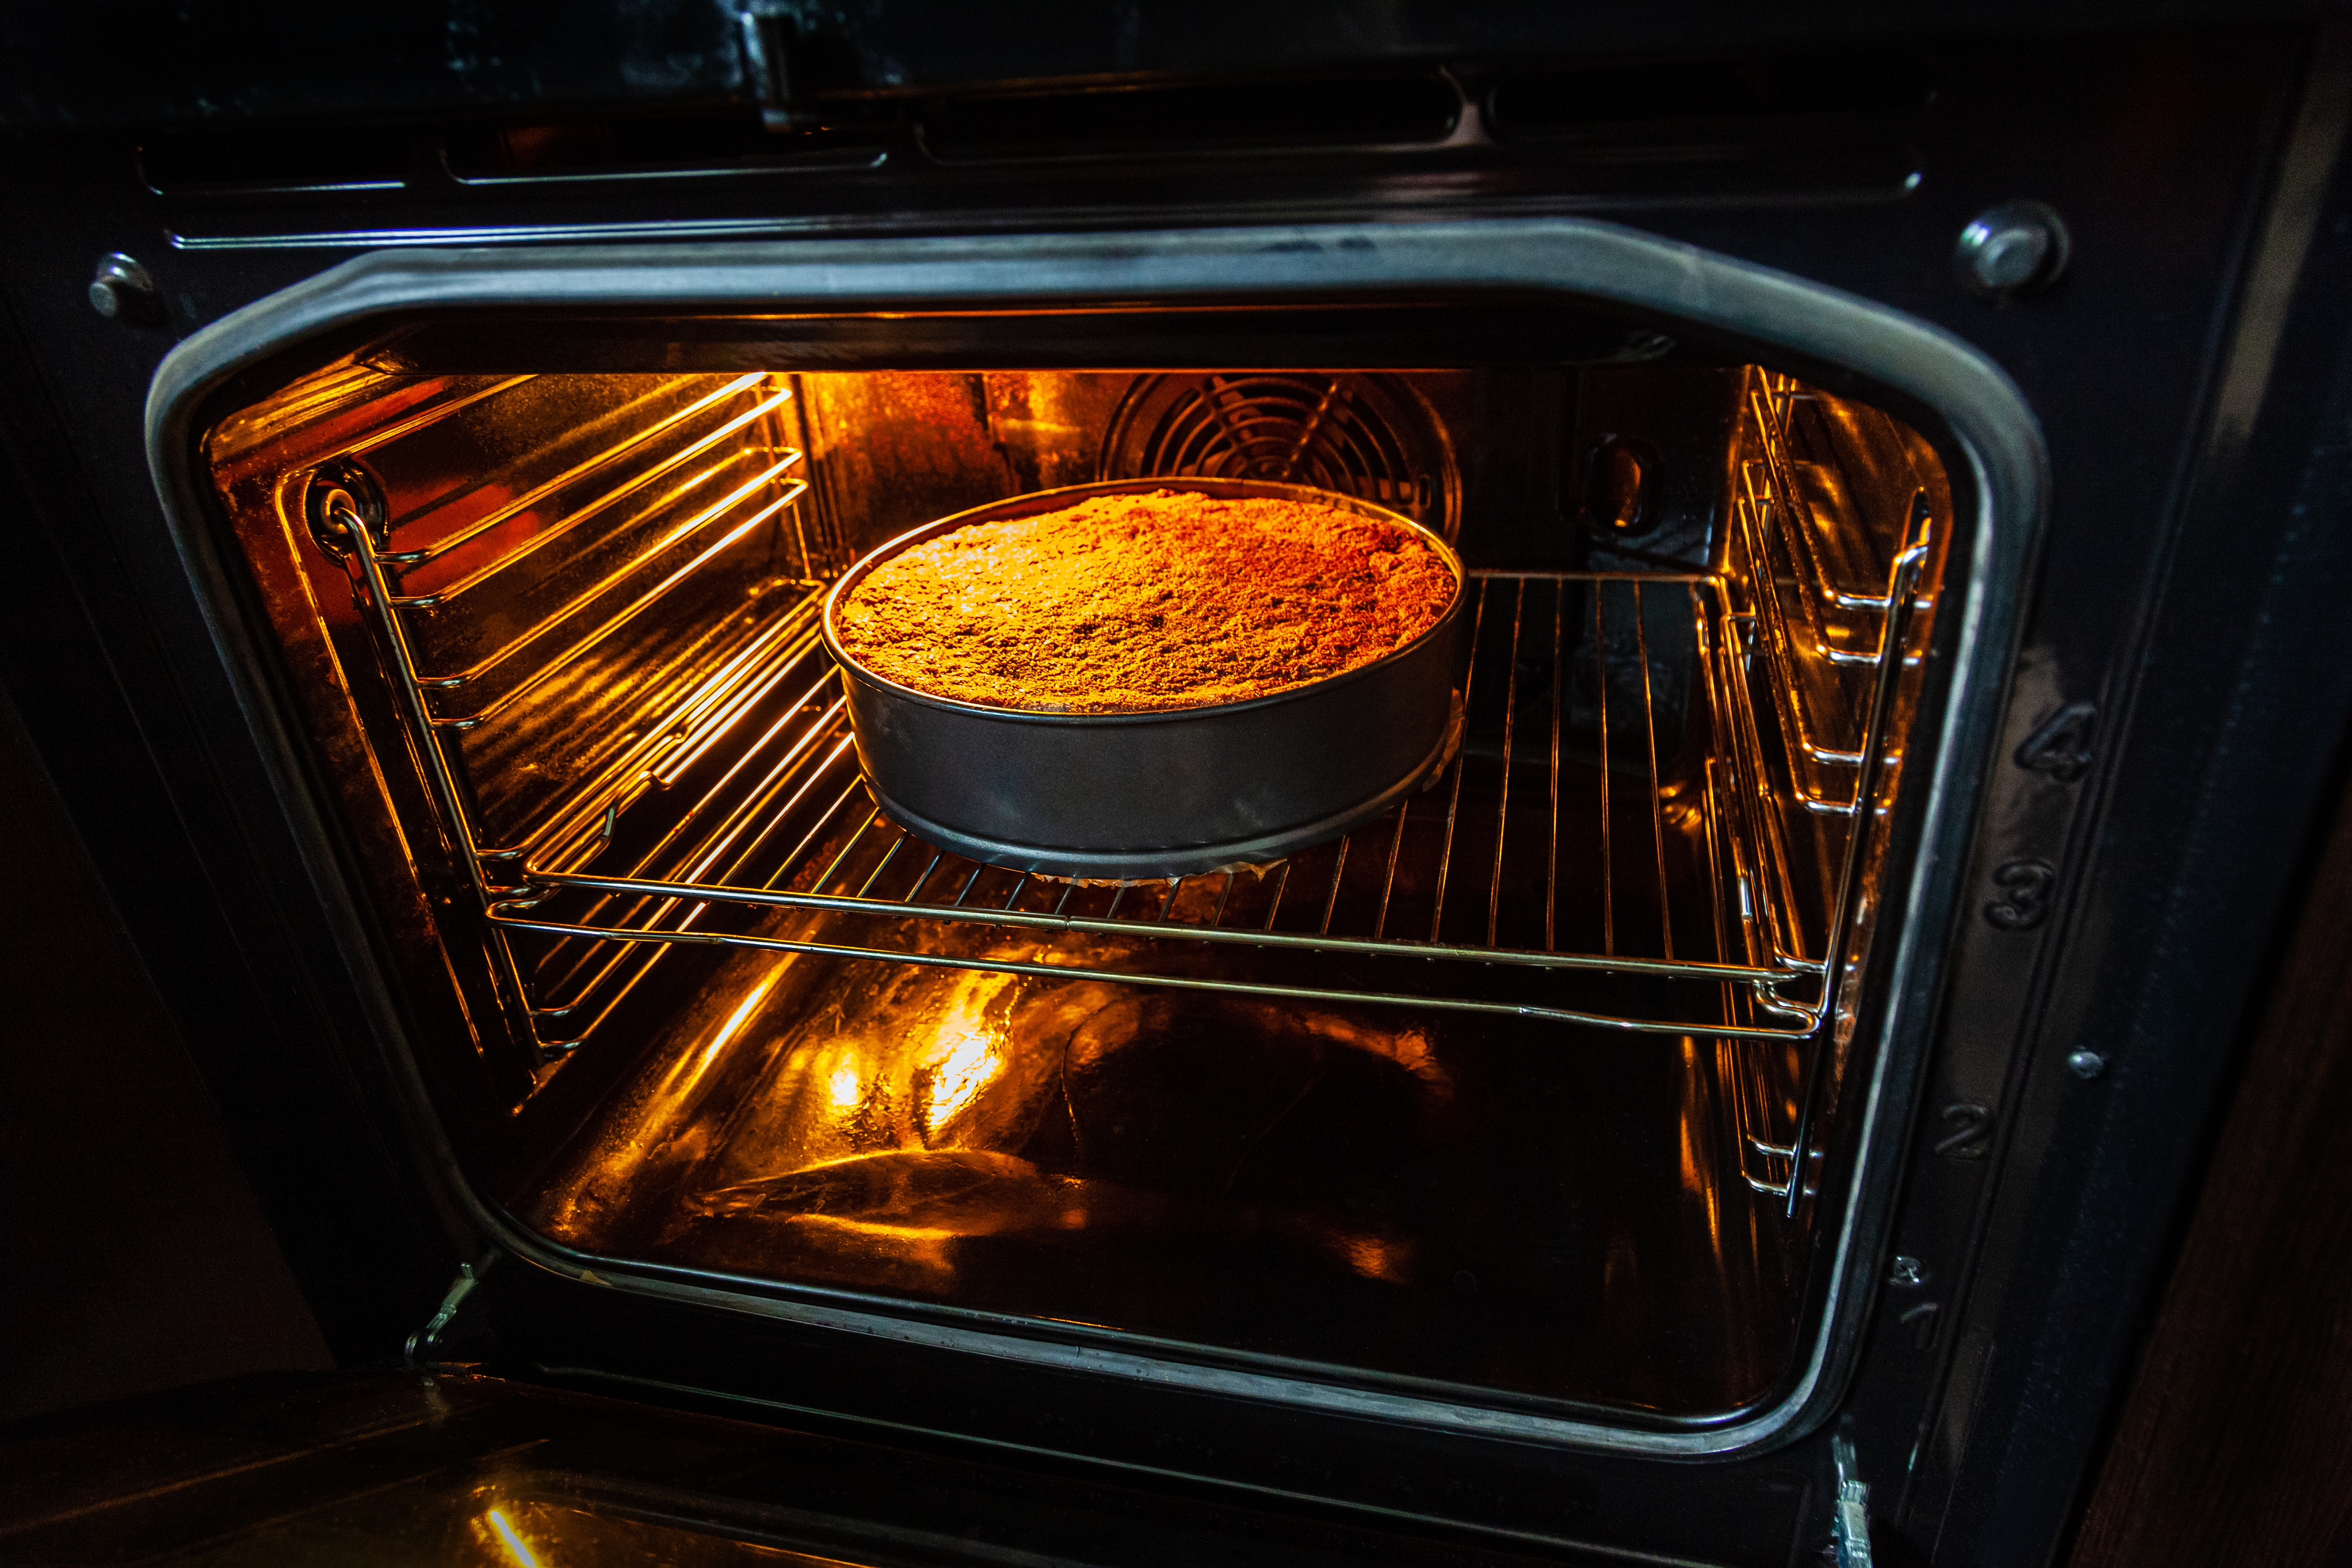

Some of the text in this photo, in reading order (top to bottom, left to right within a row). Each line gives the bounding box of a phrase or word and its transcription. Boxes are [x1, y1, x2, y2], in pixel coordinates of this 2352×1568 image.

[2014, 701, 2096, 783] 4
[1984, 858, 2053, 931] 3
[1934, 1102, 1994, 1160] 2
[1899, 1301, 1941, 1351] 1
